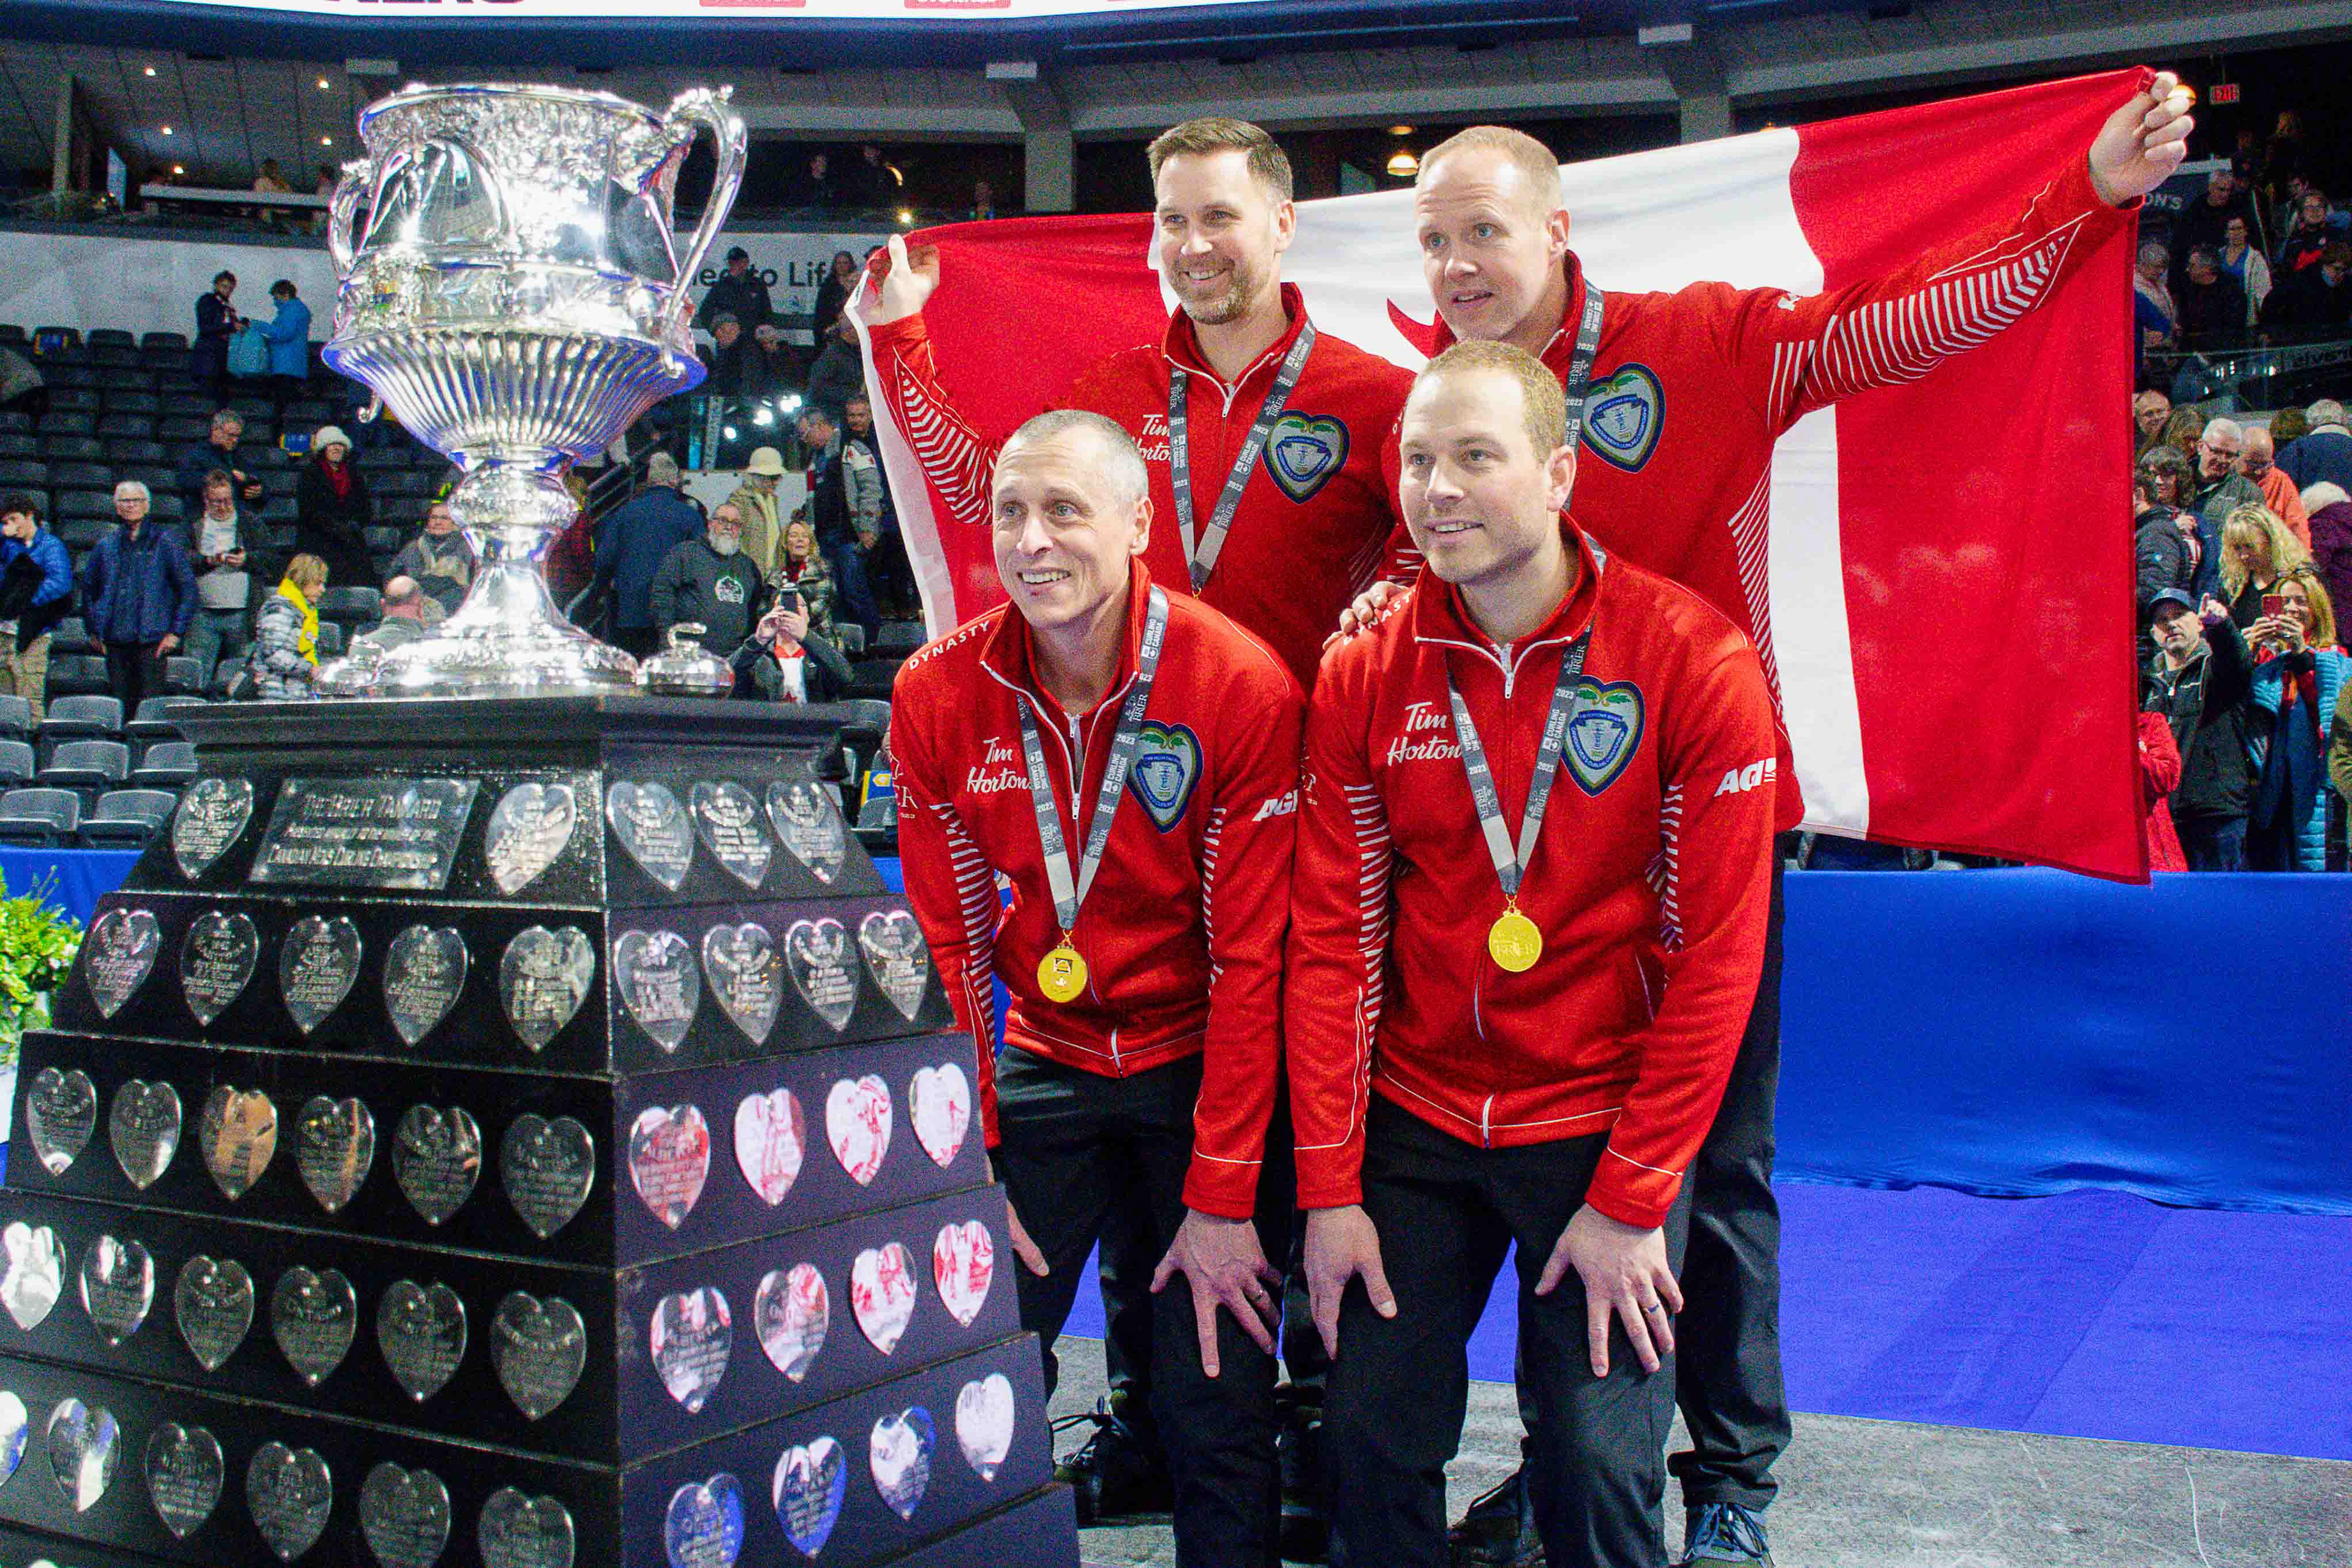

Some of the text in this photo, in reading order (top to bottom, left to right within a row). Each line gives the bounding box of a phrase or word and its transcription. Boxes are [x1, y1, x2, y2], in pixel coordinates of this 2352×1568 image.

[789, 261, 827, 287] Lif
[1253, 424, 1270, 435] 2023
[1227, 480, 1244, 491] 2023
[1145, 619, 1157, 645] CURLING
[1152, 622, 1164, 647] CANADA
[909, 620, 990, 671] DYNASTY
[1556, 688, 1575, 699] 2023
[1133, 694, 1148, 722] BRIER
[1405, 701, 1447, 732] Tim
[1547, 709, 1560, 737] CURLING
[1554, 712, 1567, 739] CANADA
[983, 736, 1012, 764] Tim
[1116, 734, 1136, 745] 2023
[1387, 735, 1462, 767] Horton
[1107, 753, 1121, 780] CURLING
[1115, 757, 1128, 782] CANADA
[1469, 764, 1487, 775] 2023
[1537, 761, 1555, 774] 2023
[1037, 802, 1054, 813] 2023
[1098, 803, 1115, 814] 2023
